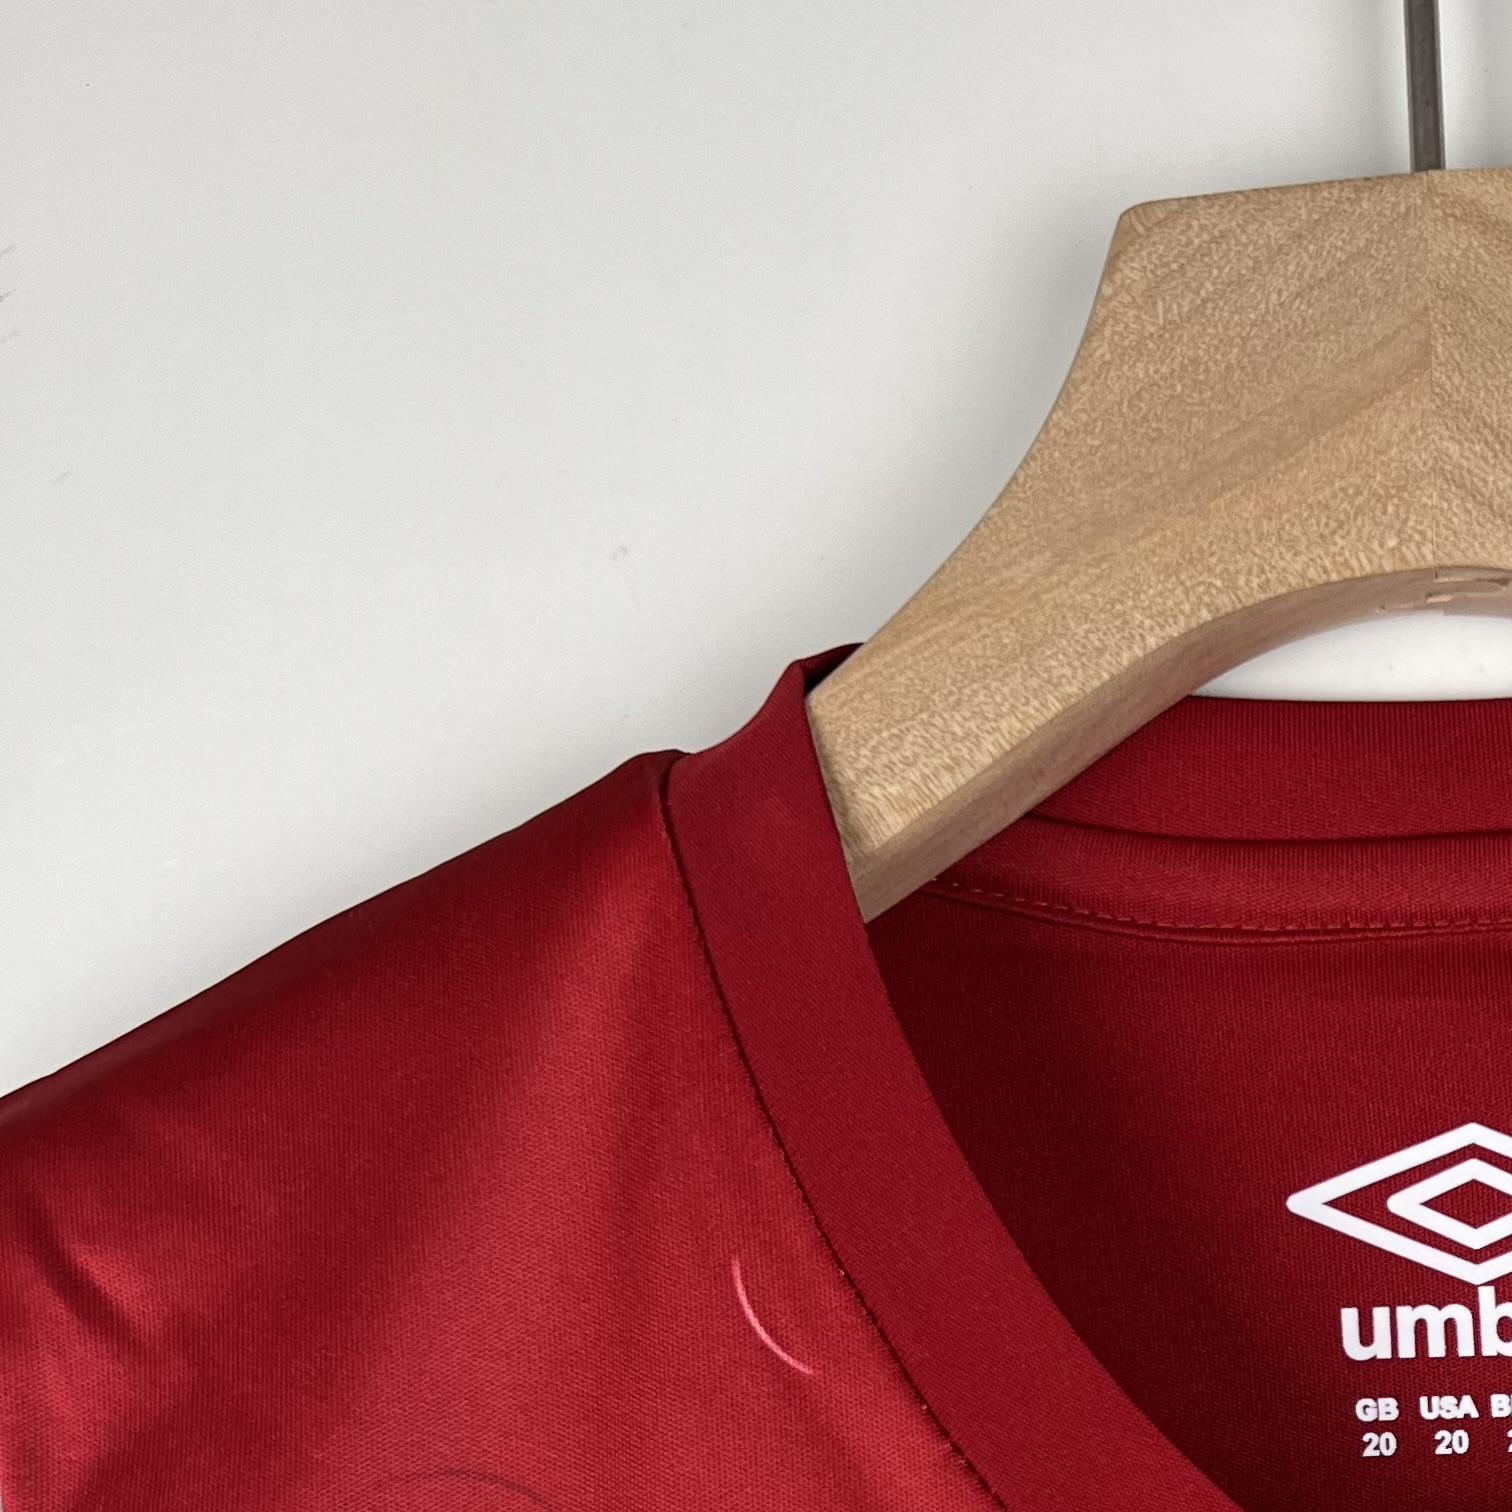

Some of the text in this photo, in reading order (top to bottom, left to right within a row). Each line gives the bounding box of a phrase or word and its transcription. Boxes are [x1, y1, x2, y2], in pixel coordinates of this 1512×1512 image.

[1355, 1397, 1400, 1422] GB
[1420, 1394, 1480, 1420] USA
[1362, 1431, 1398, 1458] 20
[1434, 1429, 1470, 1456] 20
